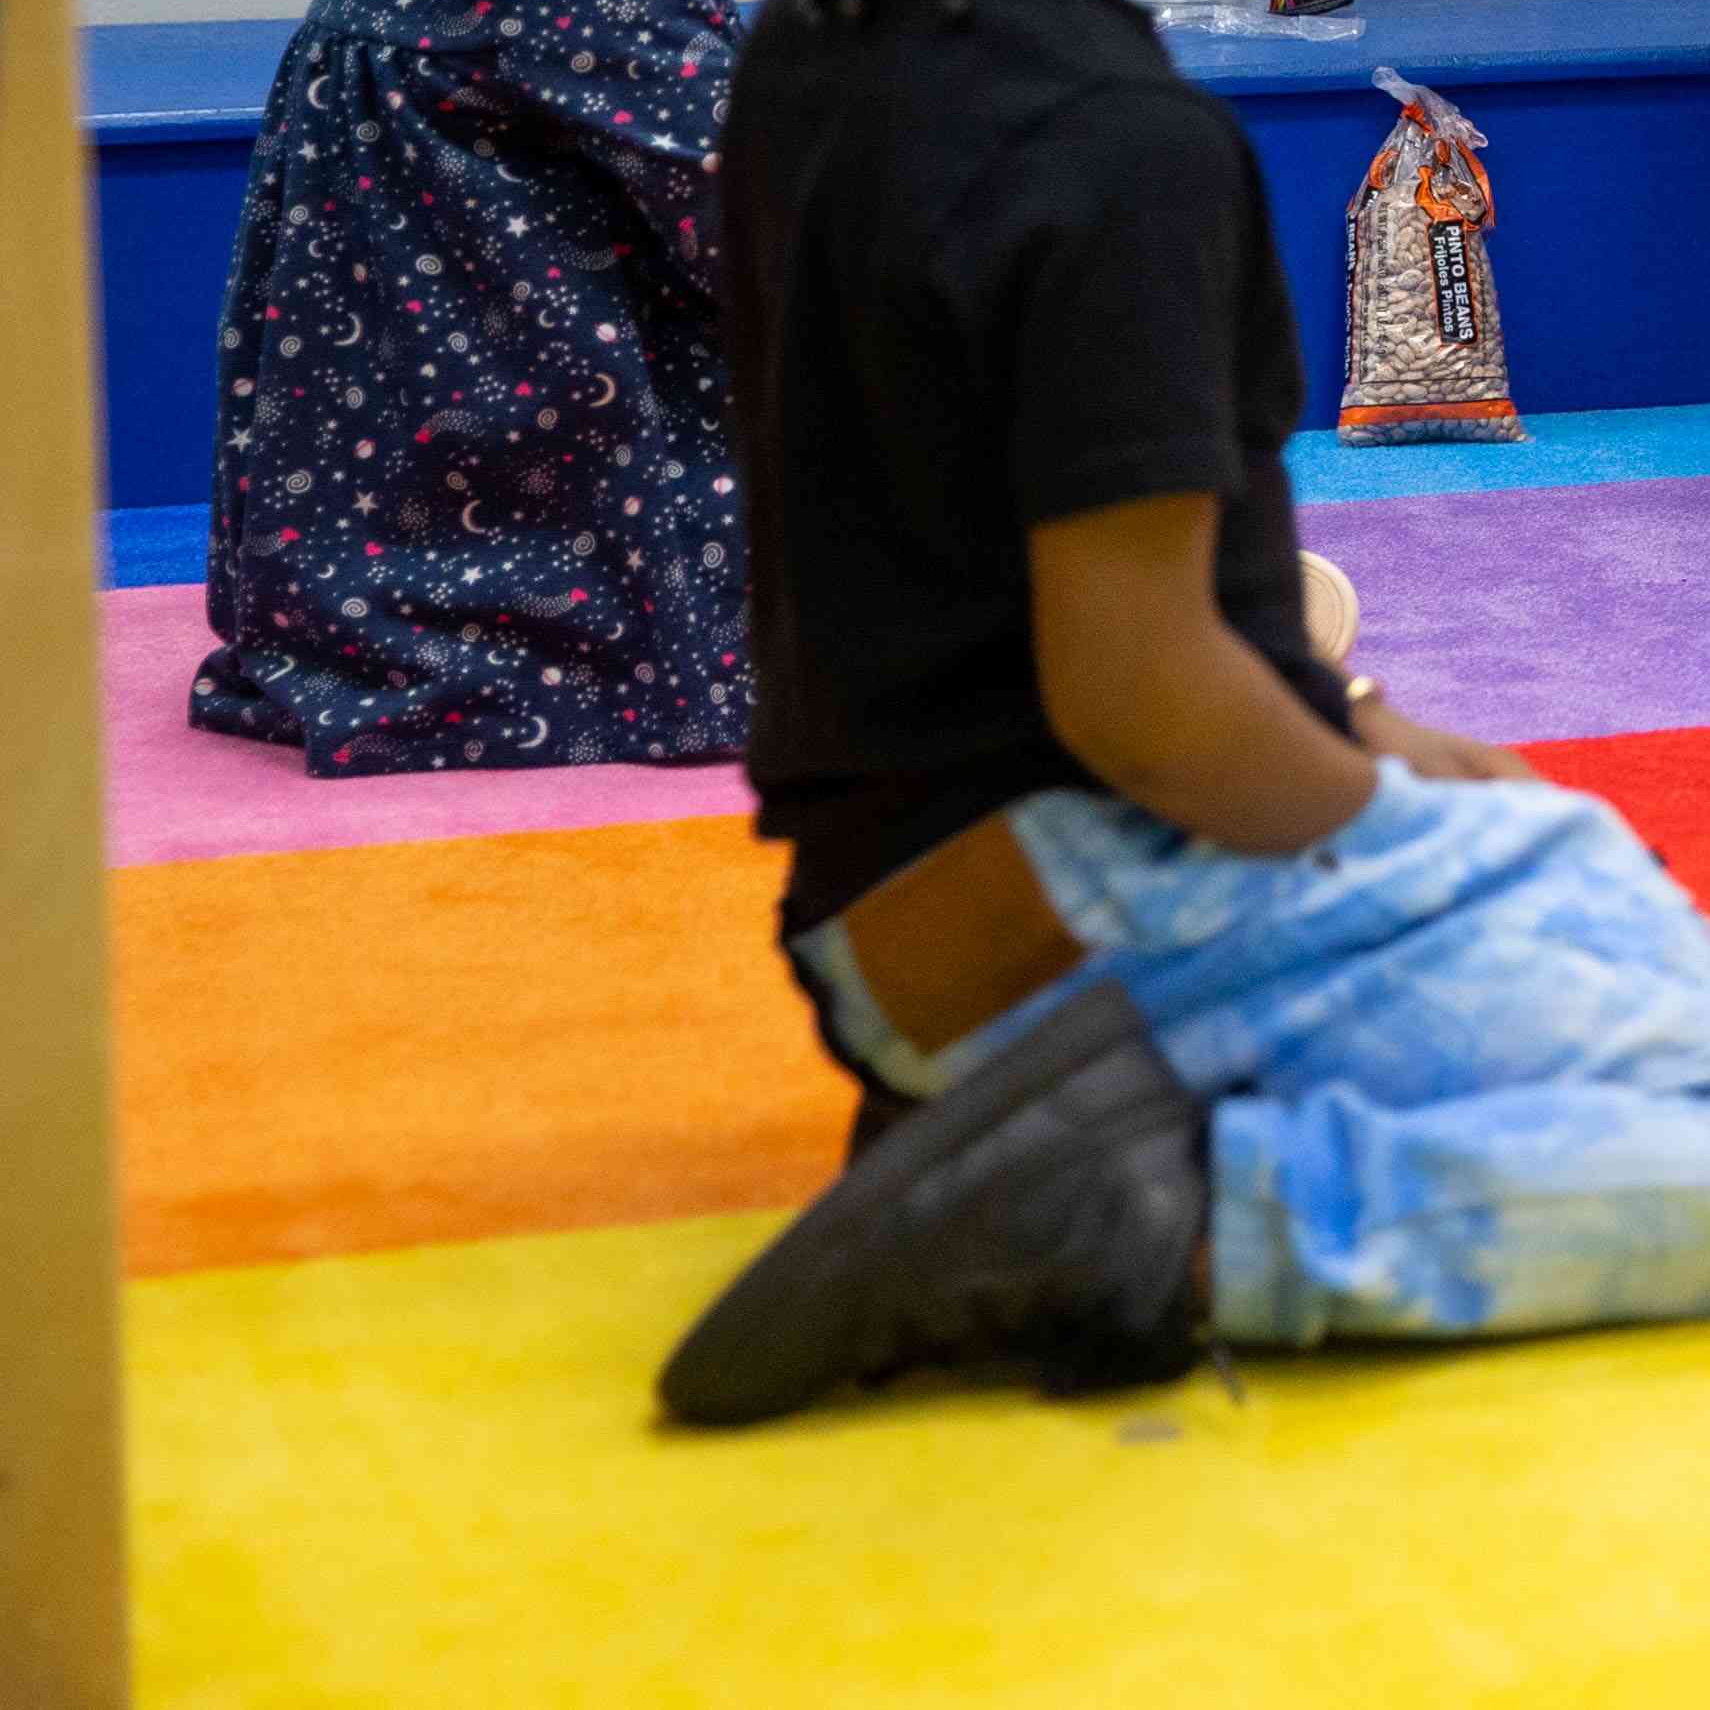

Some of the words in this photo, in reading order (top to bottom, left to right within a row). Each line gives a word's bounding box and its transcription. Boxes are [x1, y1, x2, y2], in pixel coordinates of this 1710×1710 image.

[1446, 225, 1466, 278] PINTO
[1433, 236, 1449, 286] Frijoles
[1441, 290, 1454, 332] Pintos
[1453, 284, 1474, 340] BEANS
